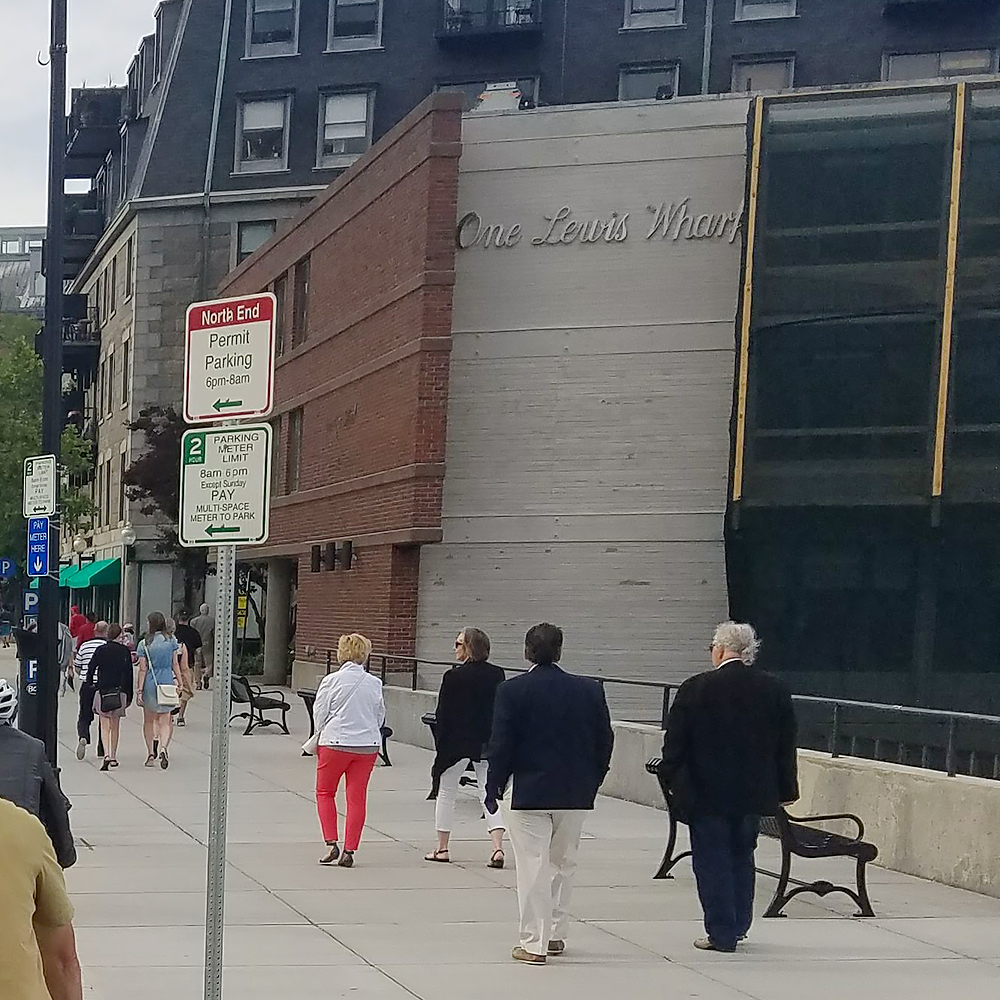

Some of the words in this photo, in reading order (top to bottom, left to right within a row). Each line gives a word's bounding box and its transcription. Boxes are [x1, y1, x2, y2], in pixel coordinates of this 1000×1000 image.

[457, 209, 522, 248] One
[531, 204, 630, 246] Lewis
[646, 196, 744, 244] Wharf
[201, 307, 233, 326] North
[237, 302, 260, 321] End
[209, 329, 250, 348] Permit
[205, 352, 252, 370] Parking
[206, 373, 250, 390] 6pm-8am
[213, 433, 259, 444] PARKING
[190, 437, 202, 455] 2
[218, 443, 254, 453] METER
[222, 453, 249, 463] LIMIT
[200, 468, 222, 478] 8am
[200, 480, 222, 489] Except
[223, 479, 246, 488] Sunday
[211, 489, 235, 501] PAY
[196, 502, 250, 513] MULTI-SPACE
[190, 513, 218, 522] METER
[219, 512, 231, 521] TO
[232, 511, 255, 520] PARK
[33, 521, 44, 530] PAY
[29, 532, 47, 541] METER
[31, 544, 46, 553] HERE
[2, 561, 10, 574] P
[25, 592, 39, 611] P
